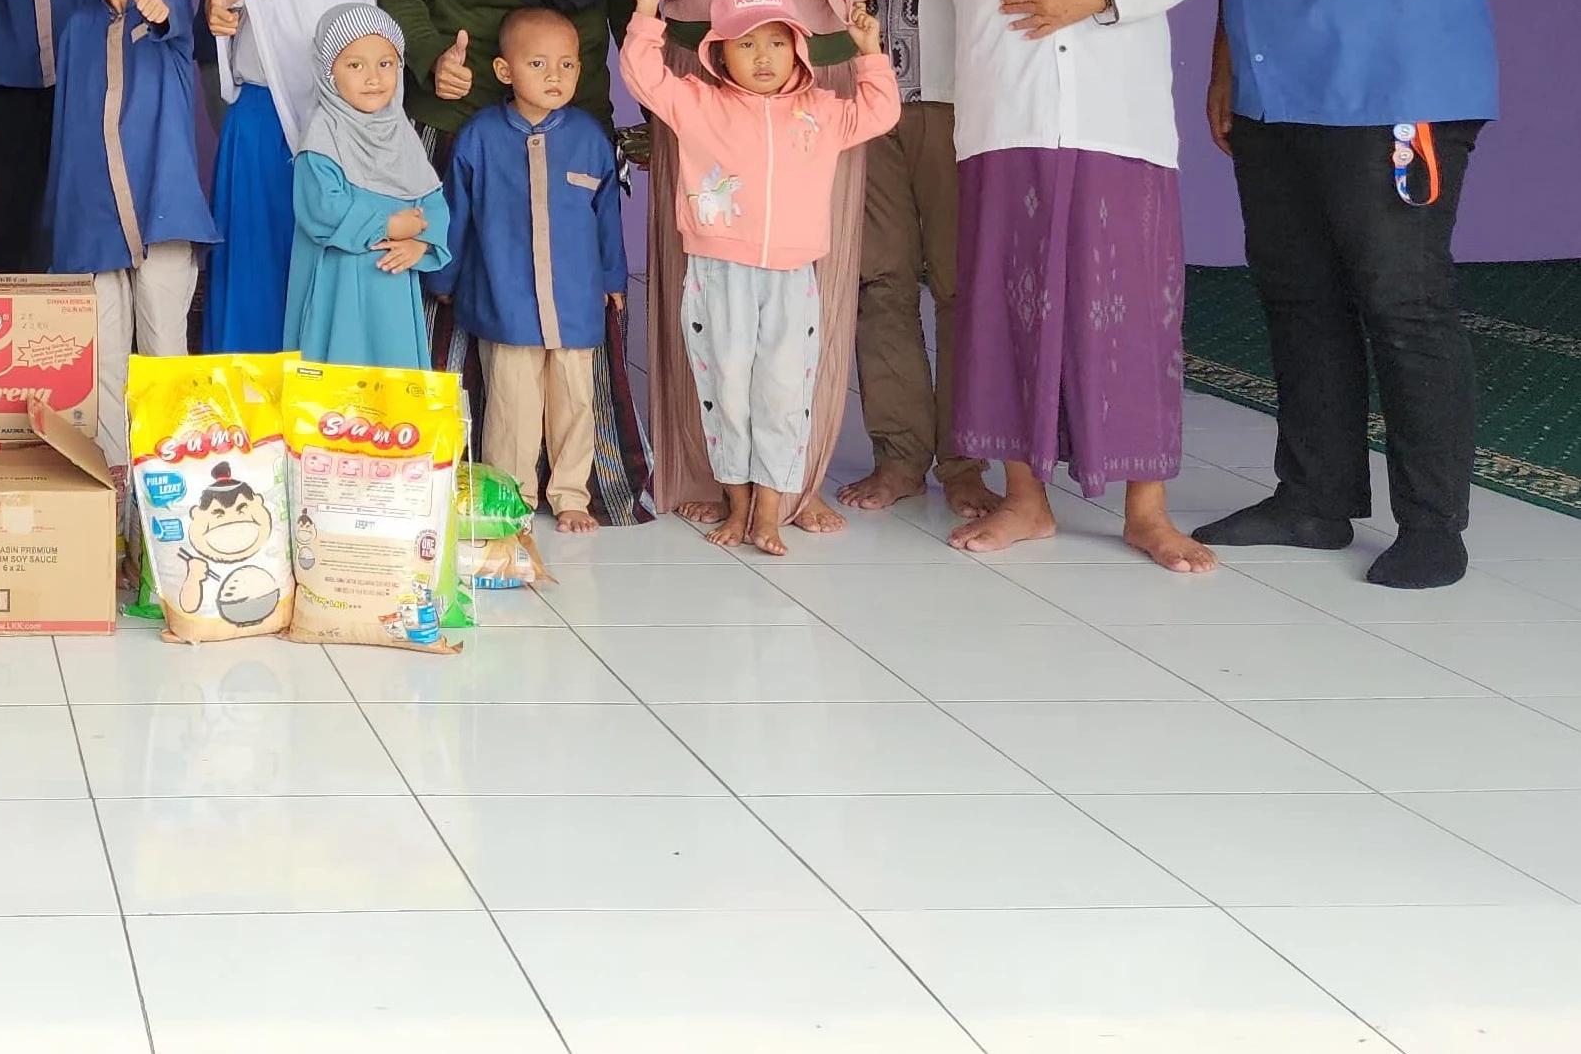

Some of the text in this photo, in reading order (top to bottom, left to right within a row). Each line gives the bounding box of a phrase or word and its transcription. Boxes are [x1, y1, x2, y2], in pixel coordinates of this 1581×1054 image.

[0, 546, 19, 554] ASIN
[21, 546, 58, 555] PREMIUM
[11, 555, 27, 563] SOY
[29, 555, 58, 563] SAUCE
